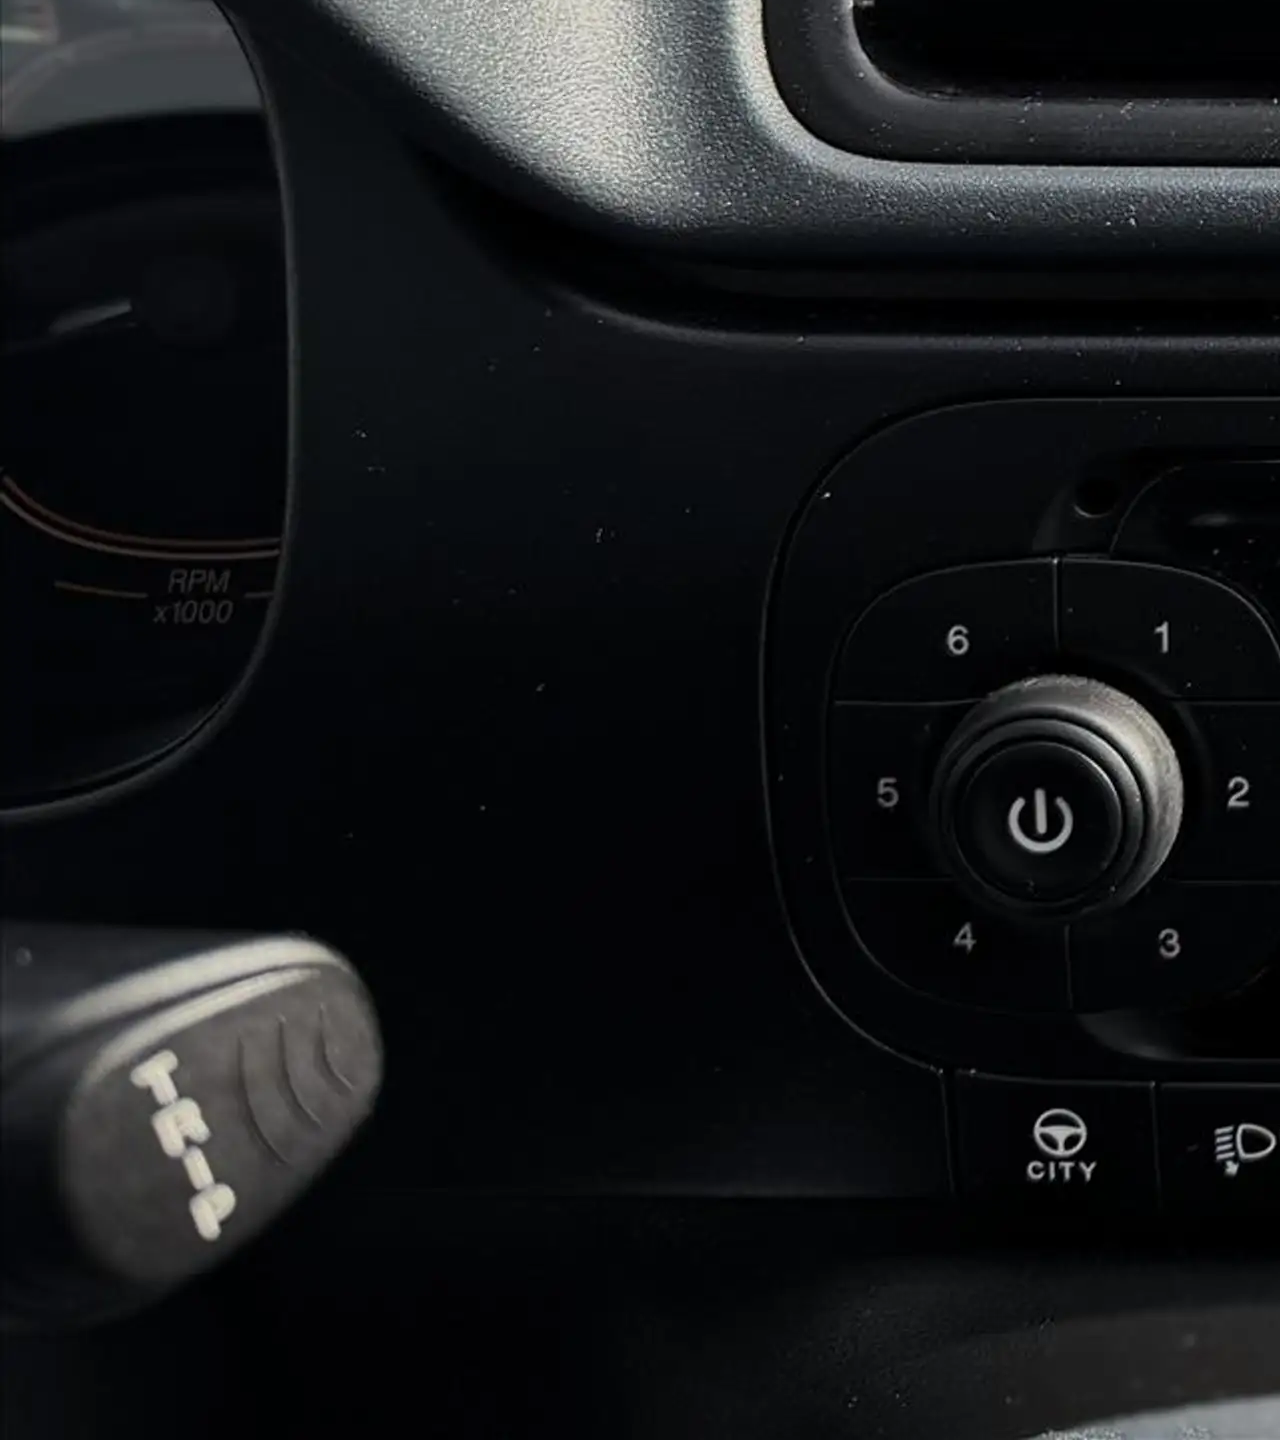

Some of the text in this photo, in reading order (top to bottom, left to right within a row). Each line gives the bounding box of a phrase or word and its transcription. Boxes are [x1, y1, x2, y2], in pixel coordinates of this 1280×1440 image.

[167, 567, 232, 594] RPM
[152, 599, 235, 625] x1000
[946, 625, 970, 655] 6
[1154, 621, 1170, 653] 1
[877, 777, 899, 807] 5
[1226, 776, 1250, 808] 2
[953, 923, 977, 952] 4
[1158, 928, 1182, 959] 3
[129, 1048, 237, 1242] TRIP
[1025, 1161, 1098, 1183] CITY
